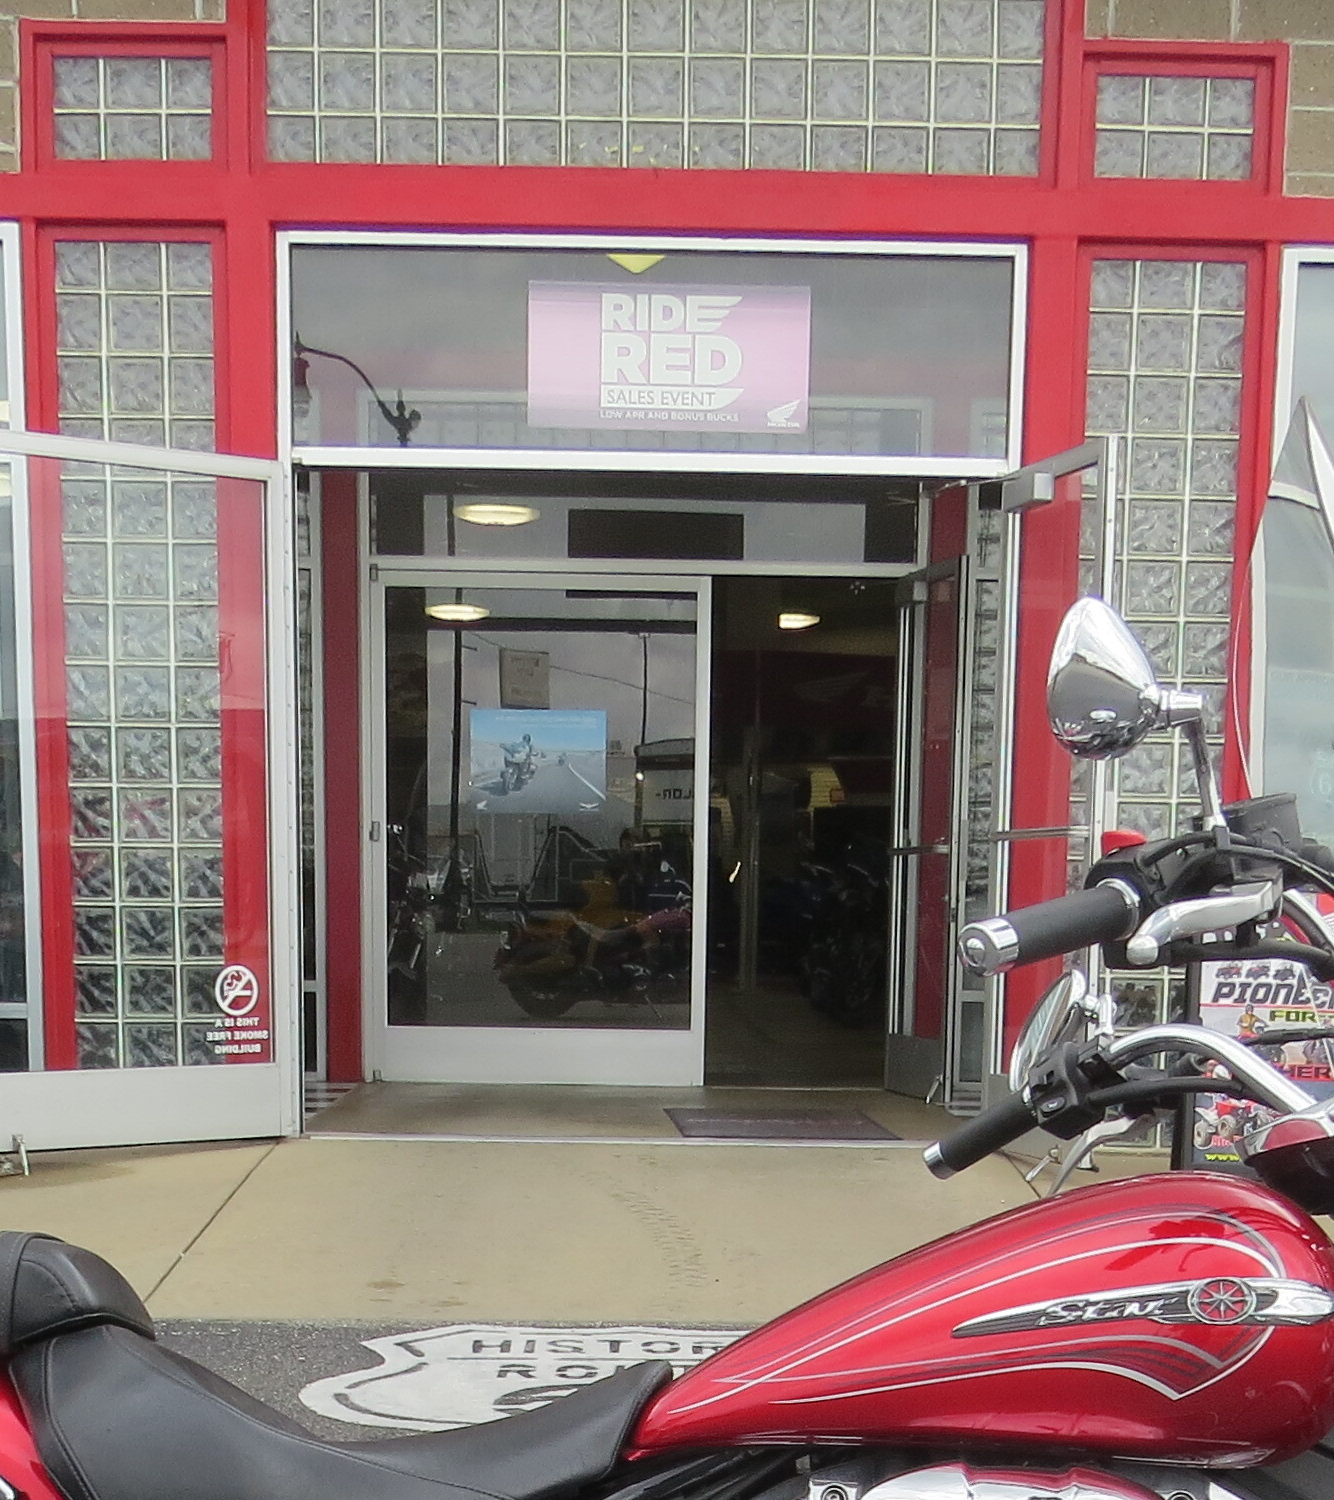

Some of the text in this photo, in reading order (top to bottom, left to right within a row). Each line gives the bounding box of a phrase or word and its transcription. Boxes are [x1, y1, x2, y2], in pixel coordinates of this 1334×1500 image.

[601, 293, 743, 332] RIDE
[601, 332, 742, 386] RED
[606, 389, 716, 408] SALES EVENT
[600, 409, 622, 419] LOW
[648, 411, 668, 420] AND
[472, 1339, 727, 1355] HISTOR
